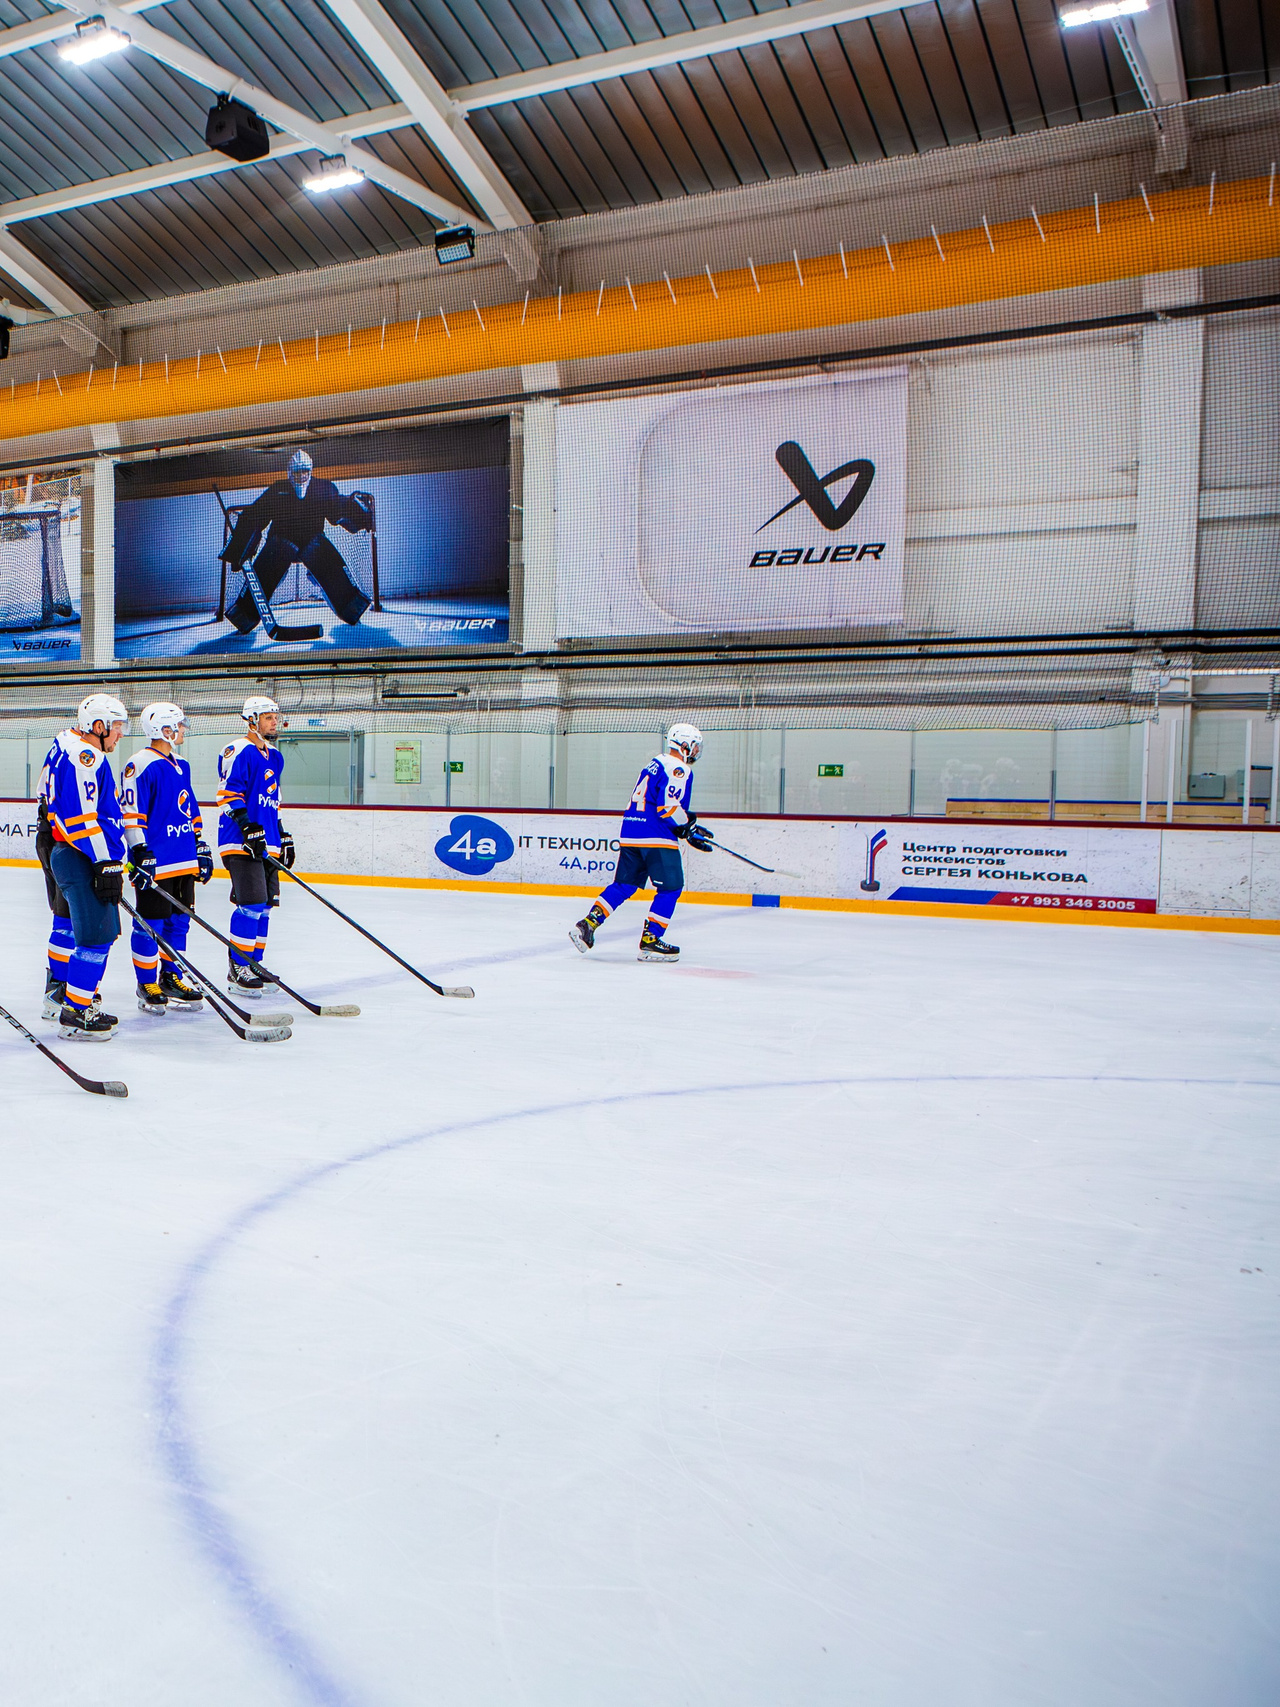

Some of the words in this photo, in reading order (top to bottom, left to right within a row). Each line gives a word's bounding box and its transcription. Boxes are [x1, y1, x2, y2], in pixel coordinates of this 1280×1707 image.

[83, 780, 98, 802] 12
[668, 785, 682, 800] 94
[902, 842, 957, 855] Центр
[962, 845, 1068, 857] подготовки
[901, 853, 1007, 866] хоккеистов
[901, 865, 972, 879] СЕРГЕЯ
[977, 868, 1088, 884] КОНЬКОВА
[1011, 895, 1029, 906] +7
[1033, 895, 1061, 907] 993
[1065, 898, 1093, 909] 346
[1098, 900, 1136, 911] 3005
